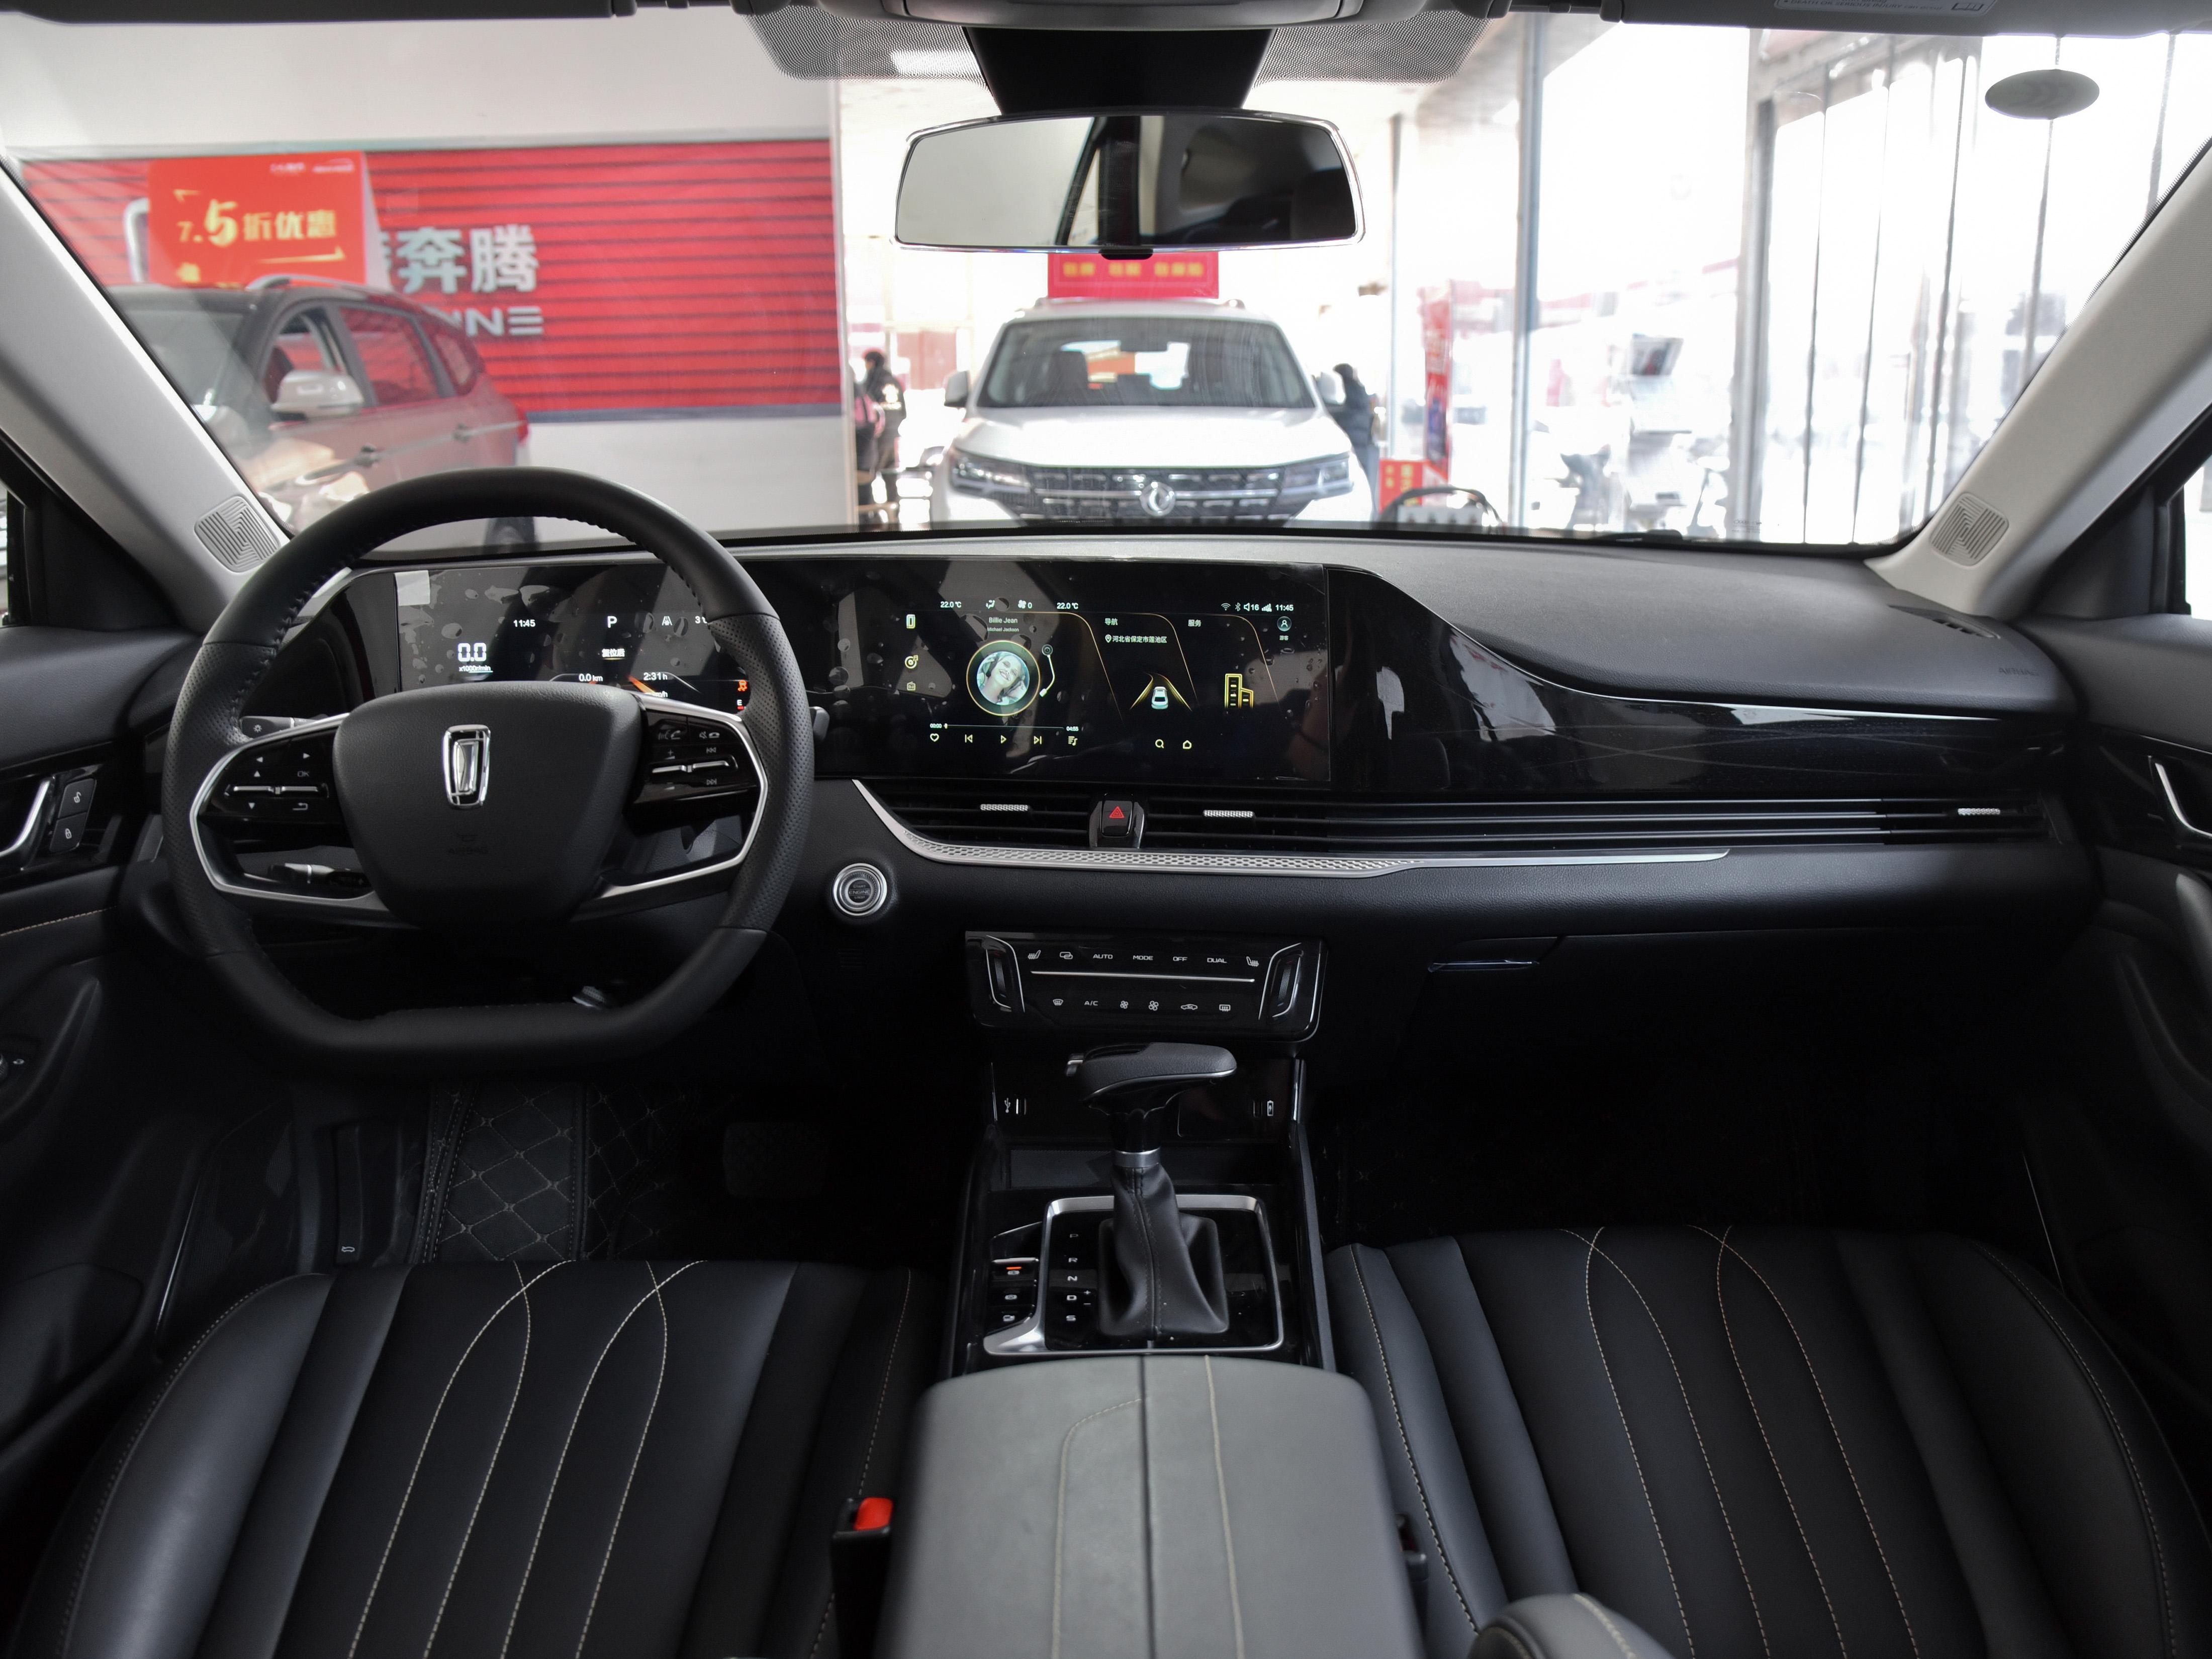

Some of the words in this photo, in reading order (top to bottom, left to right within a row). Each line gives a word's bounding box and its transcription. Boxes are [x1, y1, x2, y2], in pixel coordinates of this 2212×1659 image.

[380, 224, 540, 294] 奔腾
[513, 619, 536, 627] 11:45
[607, 615, 618, 628] P
[1104, 617, 1119, 626] 导航
[1187, 619, 1202, 627] 服务
[457, 642, 487, 662] 0.0
[578, 673, 592, 682] 0.0
[592, 674, 603, 682] km
[643, 672, 662, 681] 2:31
